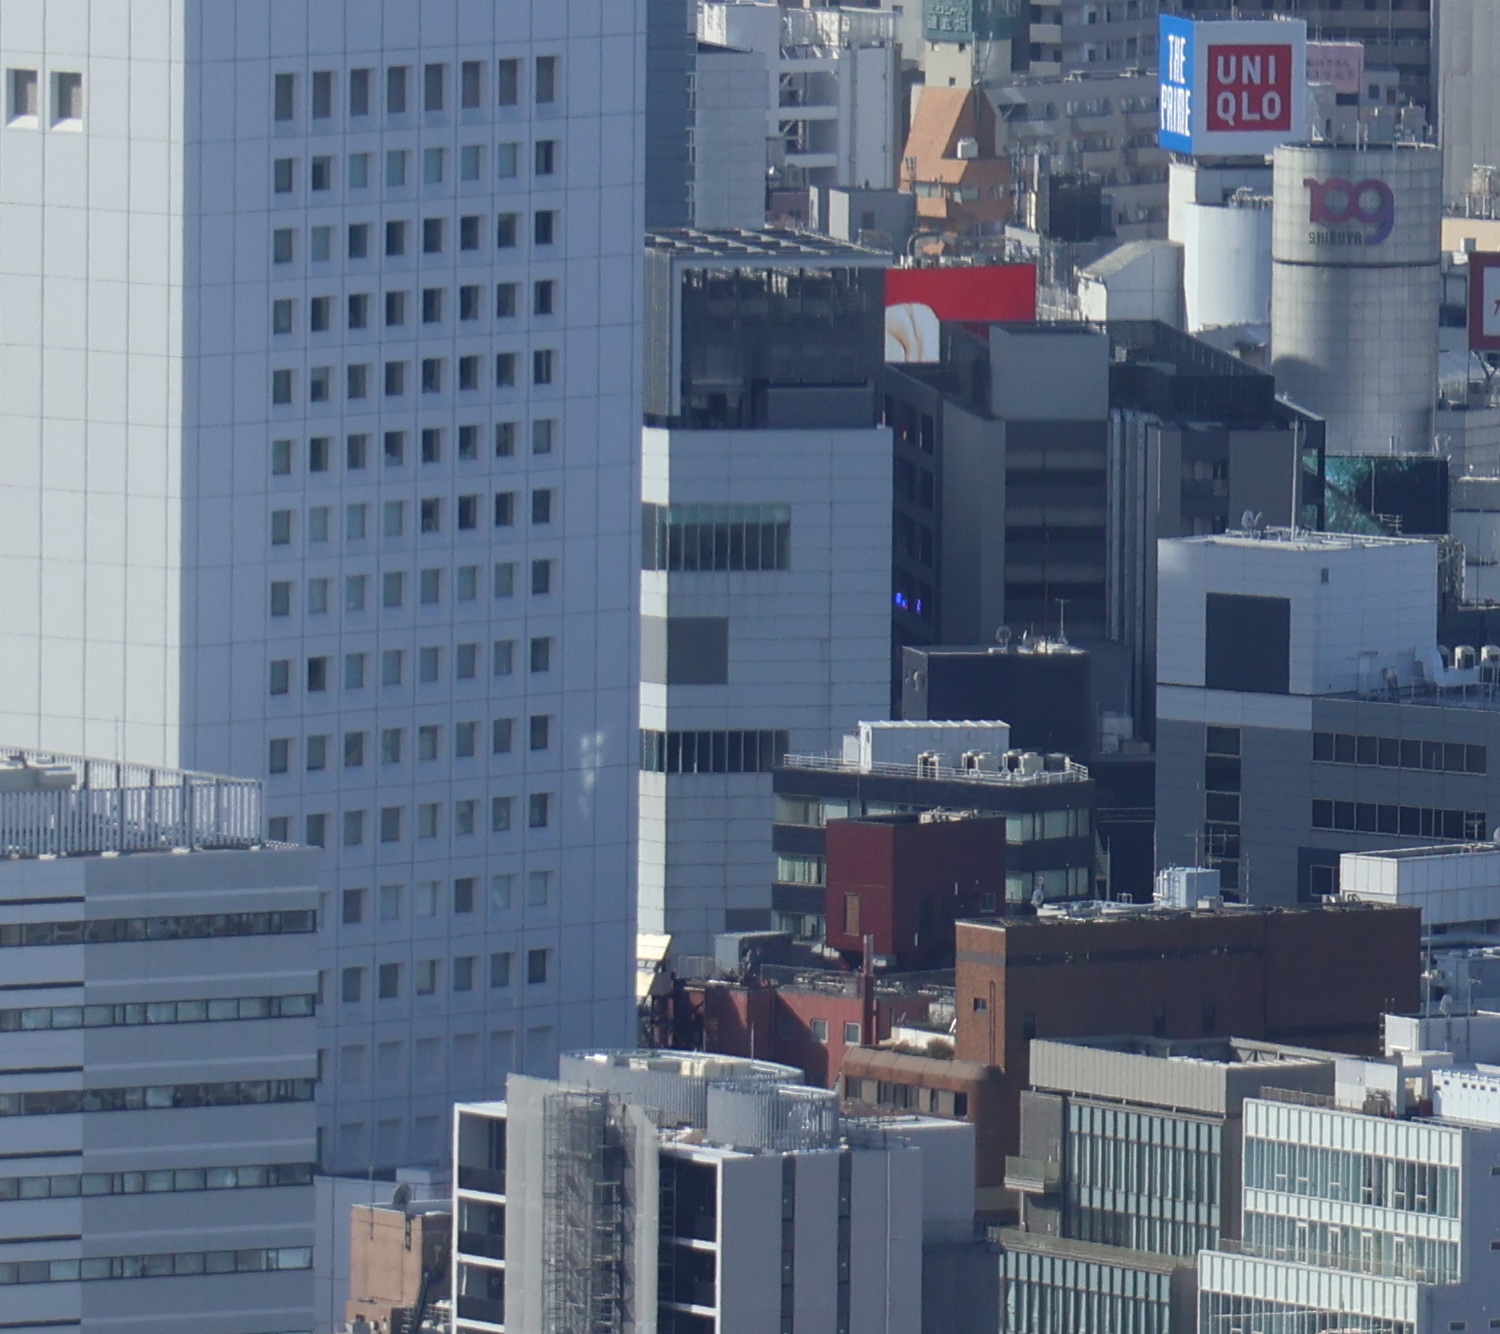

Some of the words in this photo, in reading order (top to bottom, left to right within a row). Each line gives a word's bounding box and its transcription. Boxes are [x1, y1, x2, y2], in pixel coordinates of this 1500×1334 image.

[1168, 34, 1186, 84] THE
[1217, 55, 1276, 85] UNI
[1161, 84, 1191, 137] PRIME
[1216, 91, 1282, 126] QLO
[1303, 178, 1395, 245] 109
[1308, 230, 1362, 245] SHIBUYA
